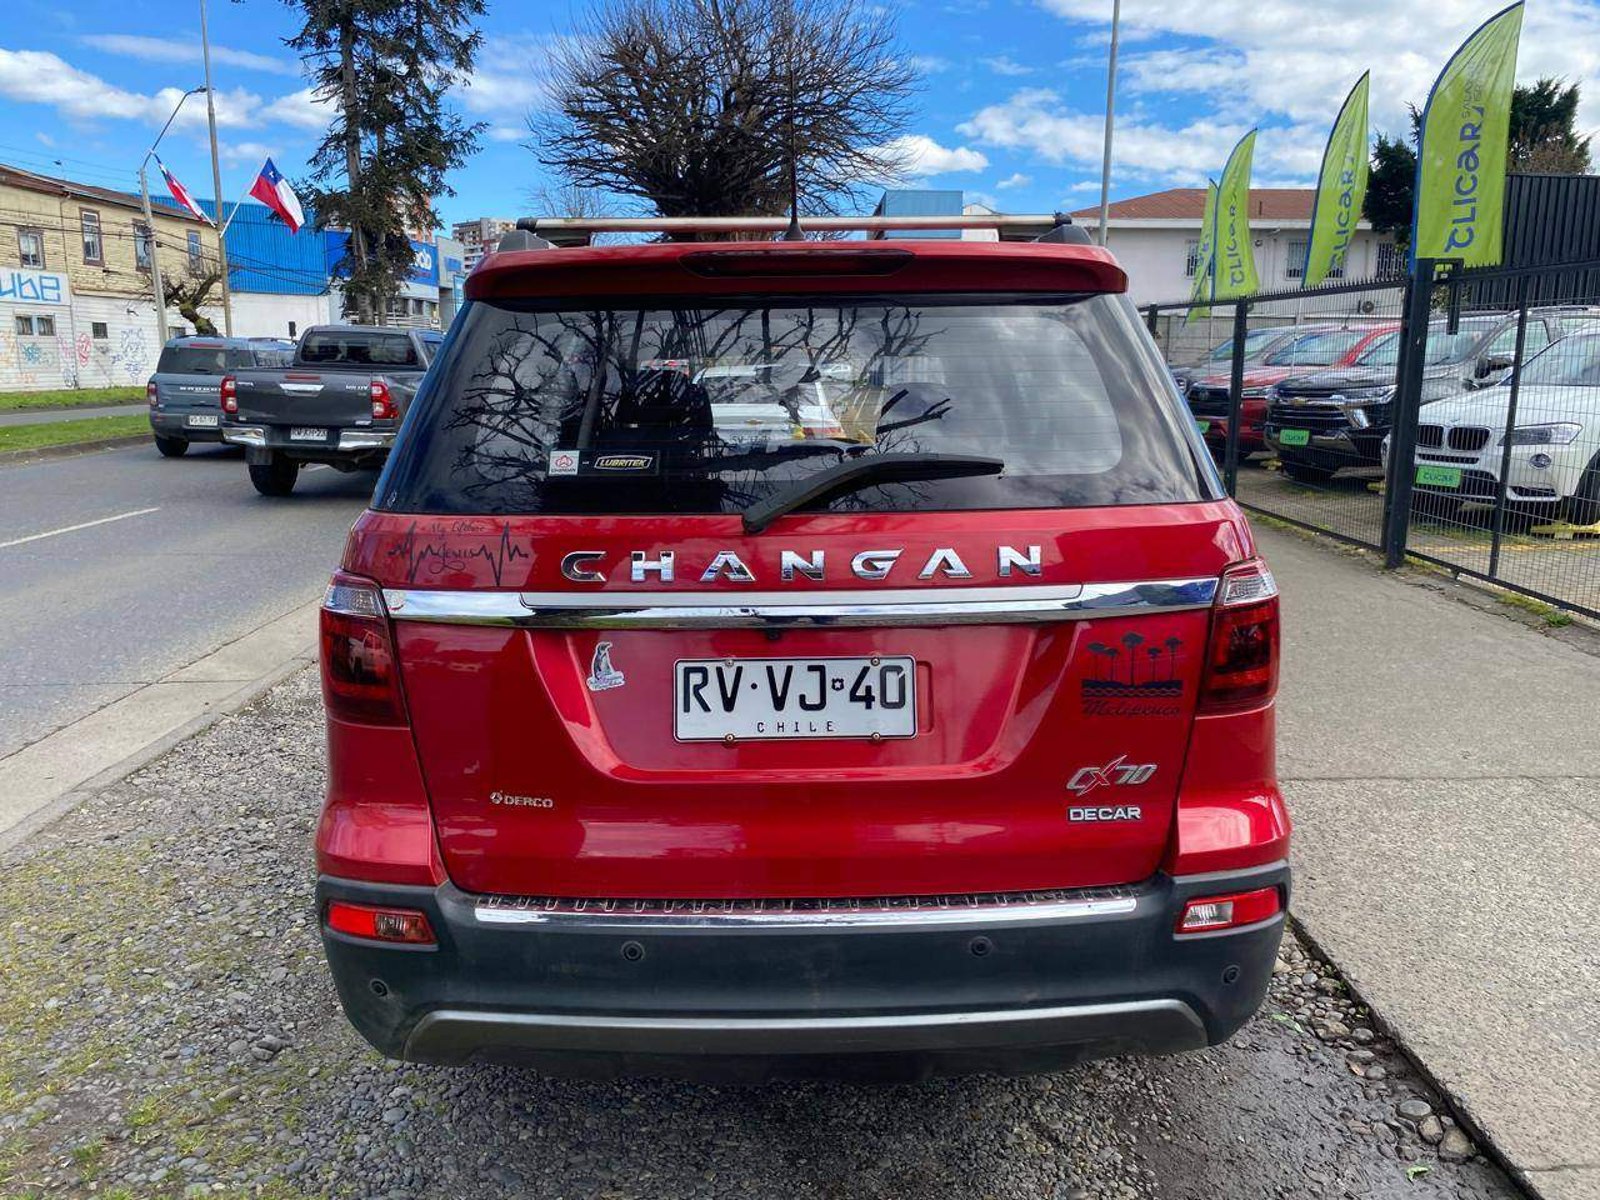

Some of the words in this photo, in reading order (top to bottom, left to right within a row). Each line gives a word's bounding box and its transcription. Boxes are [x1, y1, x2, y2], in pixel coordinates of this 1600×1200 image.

[600, 459, 647, 467] LUBRITEK
[561, 545, 1042, 583] CHANGAN
[757, 721, 835, 733] CHILE
[504, 795, 553, 808] DERCO
[1069, 807, 1141, 821] DECAR
